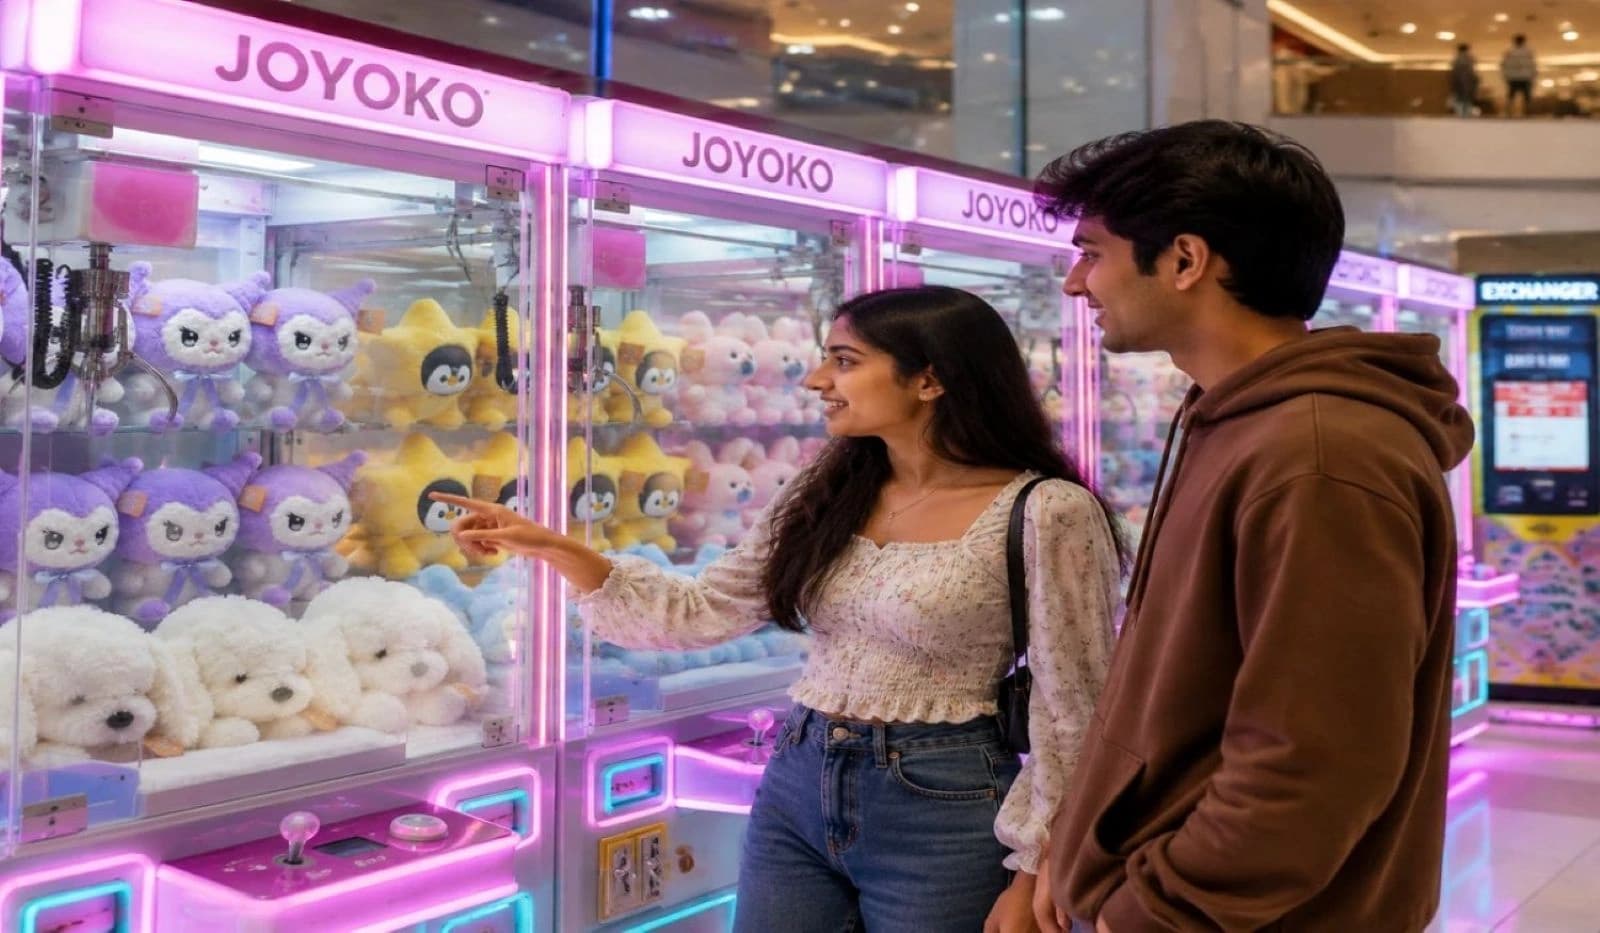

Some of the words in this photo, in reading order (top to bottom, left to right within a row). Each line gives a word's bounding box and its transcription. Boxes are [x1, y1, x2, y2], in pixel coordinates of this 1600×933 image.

[215, 34, 485, 128] JOYOKO
[682, 132, 833, 193] JOYOKO
[962, 190, 1058, 233] JOYOKO
[1480, 281, 1599, 301] EXCHANGER
